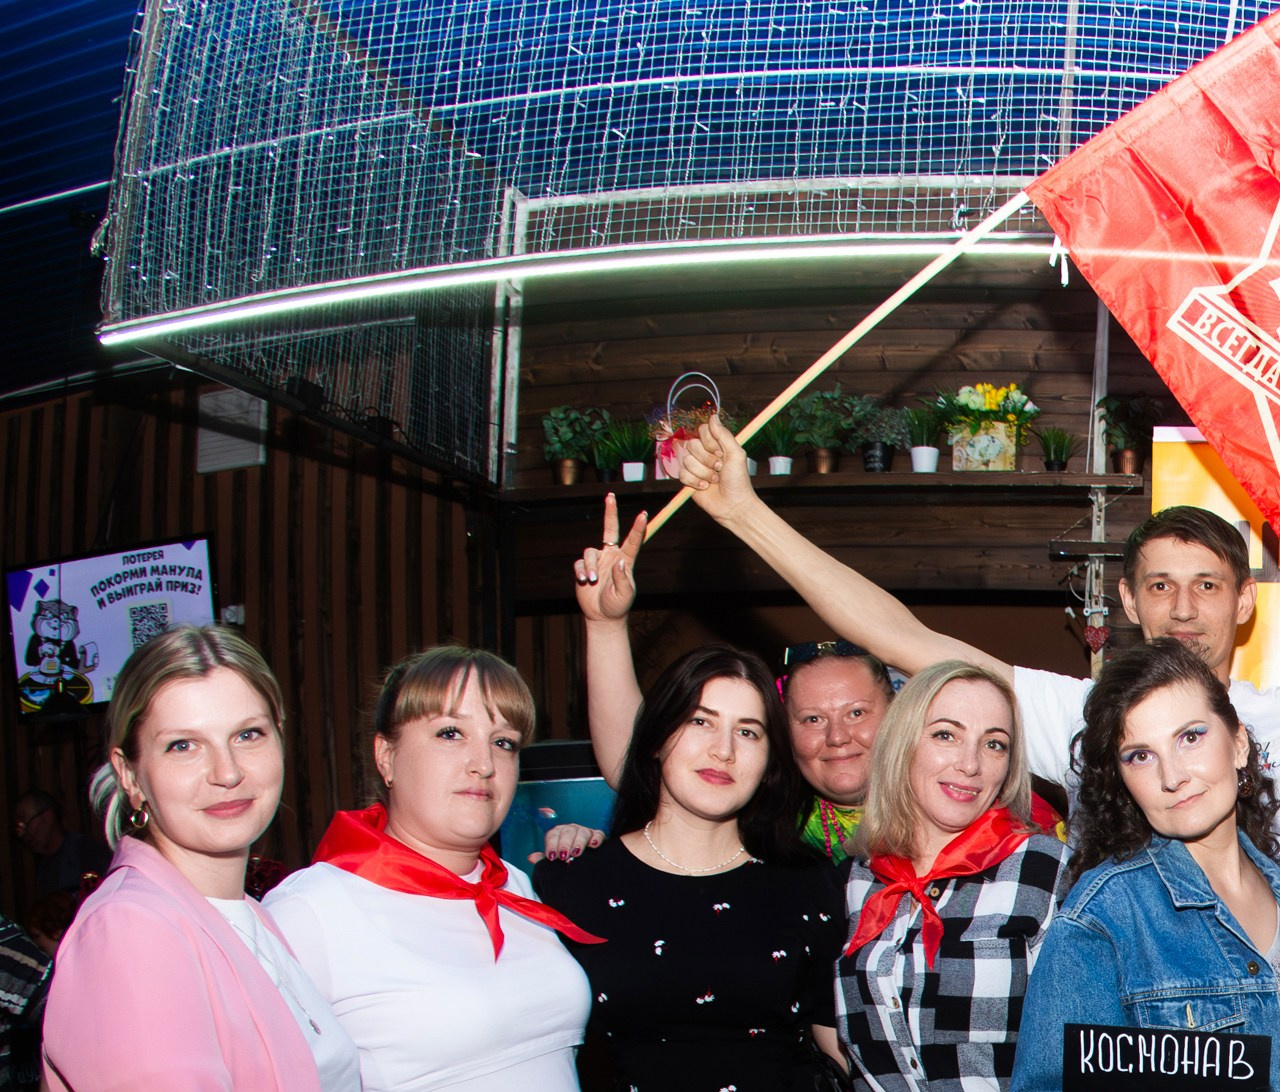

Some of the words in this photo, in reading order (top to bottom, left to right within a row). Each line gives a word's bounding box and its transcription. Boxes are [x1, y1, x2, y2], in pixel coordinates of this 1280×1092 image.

[122, 550, 164, 565] ЛОТЕРЕЯ
[90, 565, 147, 597] ПОКОРМИ
[150, 565, 203, 581] МАНУЛА
[96, 597, 107, 609] И
[106, 578, 163, 604] ВЫИГРАЙ
[165, 580, 202, 595] ПРИЗ!
[1080, 1030, 1255, 1080] КОСМОНАВ
